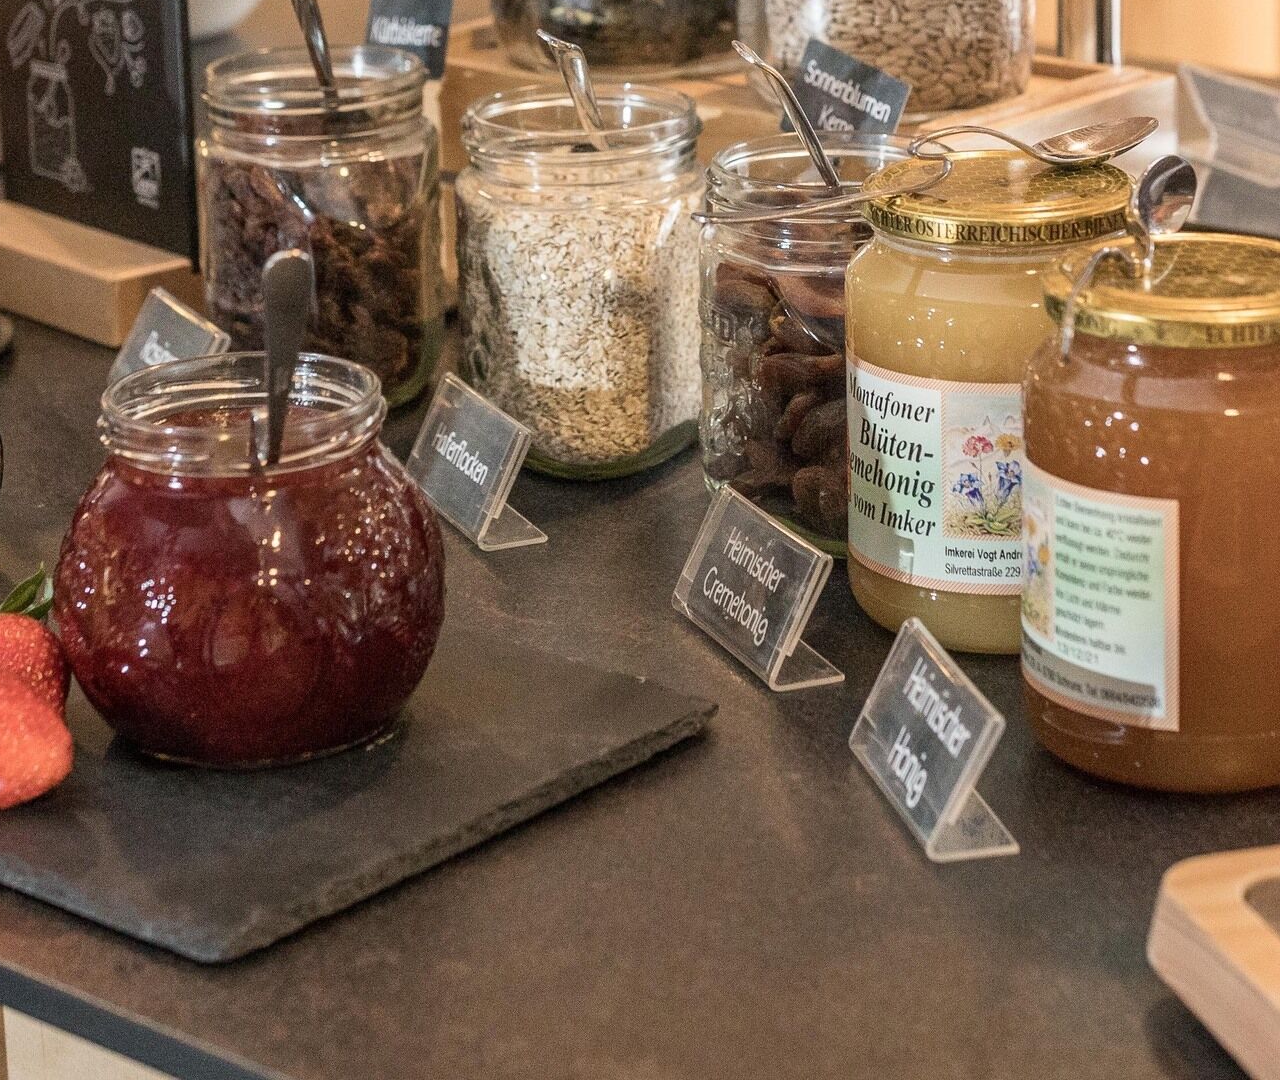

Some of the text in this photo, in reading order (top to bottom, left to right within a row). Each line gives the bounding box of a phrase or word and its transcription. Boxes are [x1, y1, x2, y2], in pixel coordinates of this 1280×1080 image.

[803, 59, 892, 124] Sonnenblumen
[849, 372, 936, 424] Montafoner
[431, 422, 489, 486] Haferflocken
[859, 416, 935, 464] Blüten-
[849, 451, 937, 510] emehonig
[853, 492, 937, 538] vom Imker
[723, 526, 786, 593] Heimischer
[944, 546, 976, 559] Imkerei
[977, 548, 998, 562] Vogt
[944, 563, 1021, 578] Silvrettastraße 229
[703, 566, 769, 647] Cremehonig
[902, 656, 972, 758] Heimischer
[886, 724, 928, 809] Honig
